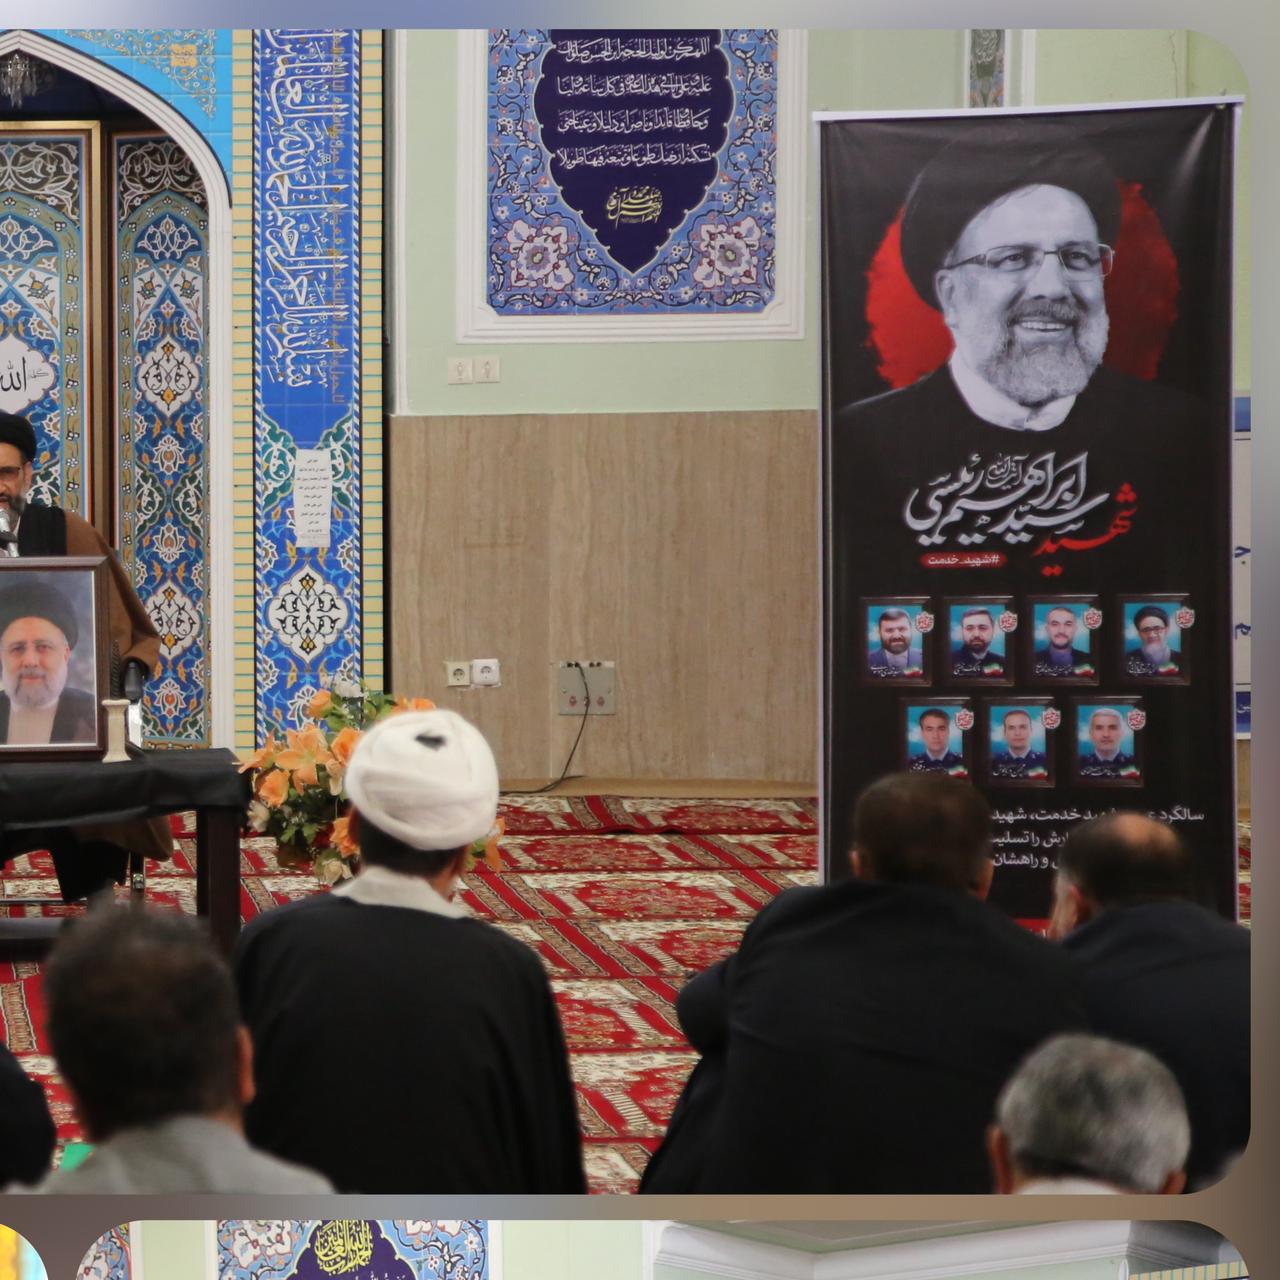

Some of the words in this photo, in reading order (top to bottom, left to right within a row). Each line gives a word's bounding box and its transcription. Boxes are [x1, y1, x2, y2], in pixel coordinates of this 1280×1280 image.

[1032, 482, 1138, 577] شهید
[991, 807, 1027, 824] شهید
[1159, 804, 1205, 824] سالگرد
